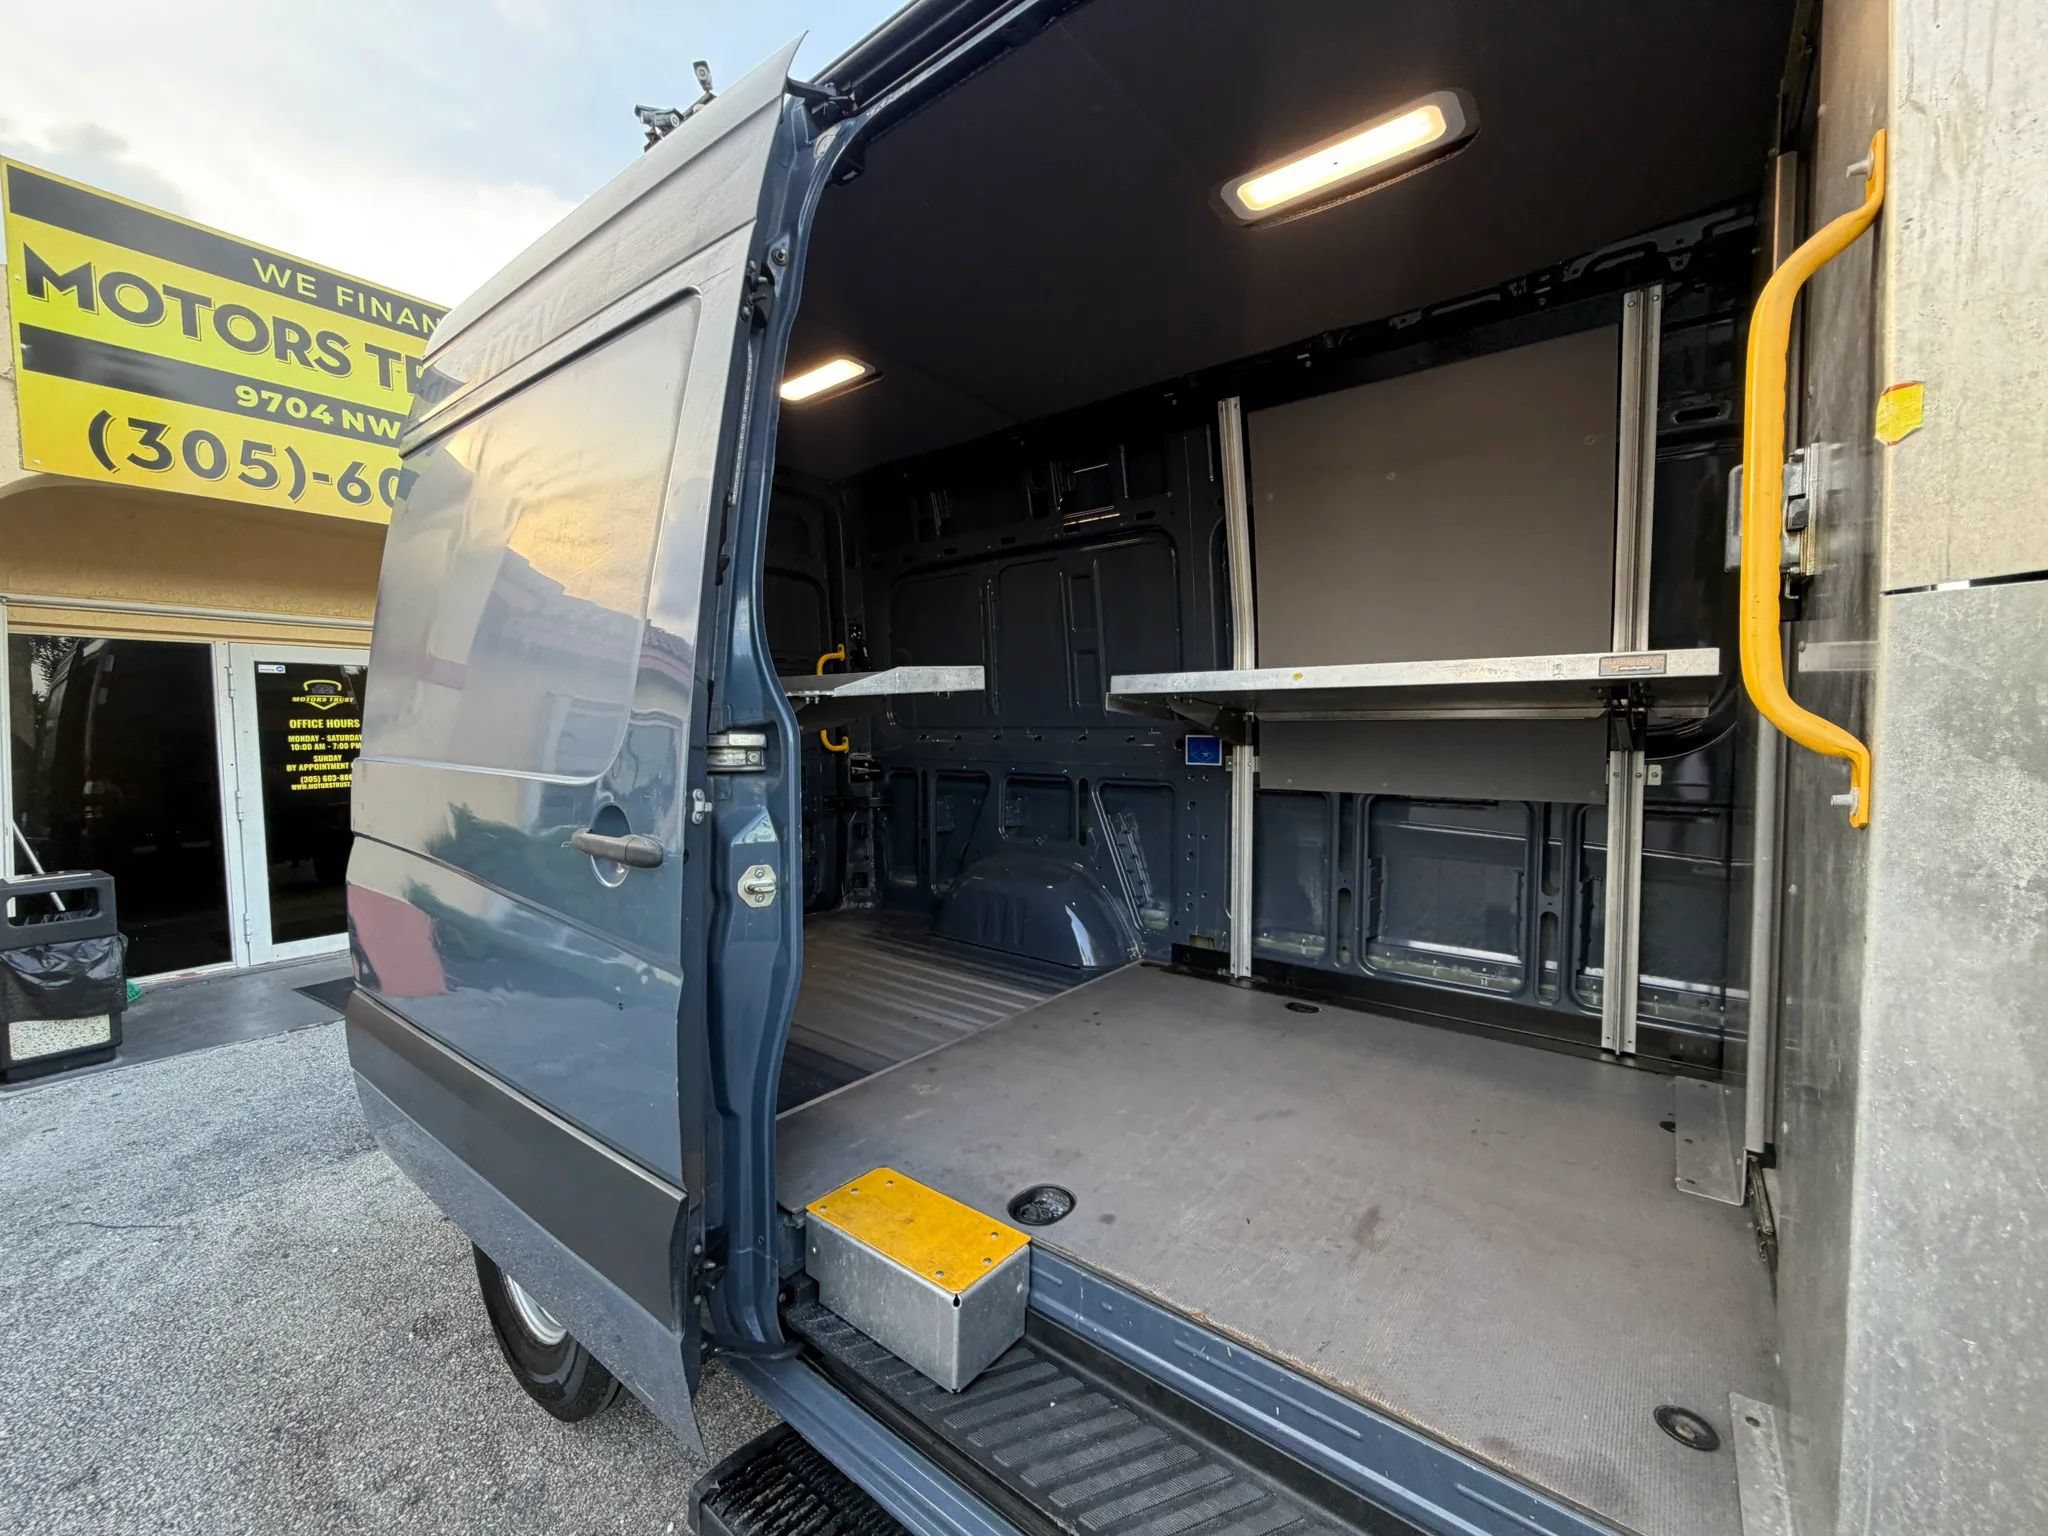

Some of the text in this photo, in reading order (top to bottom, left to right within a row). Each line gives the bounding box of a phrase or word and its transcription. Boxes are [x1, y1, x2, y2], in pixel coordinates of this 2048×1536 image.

[253, 258, 318, 299] WE
[23, 242, 352, 378] MOTORS
[234, 385, 400, 440] 9704 NW
[289, 719, 360, 729] OFFICE HOURS
[288, 735, 319, 743] MONDAY
[326, 734, 362, 742] SATURDAY
[291, 743, 313, 751] 10:00
[286, 764, 296, 772] BY
[298, 762, 349, 771] APPOINTMENT
[300, 775, 320, 784] (305)
